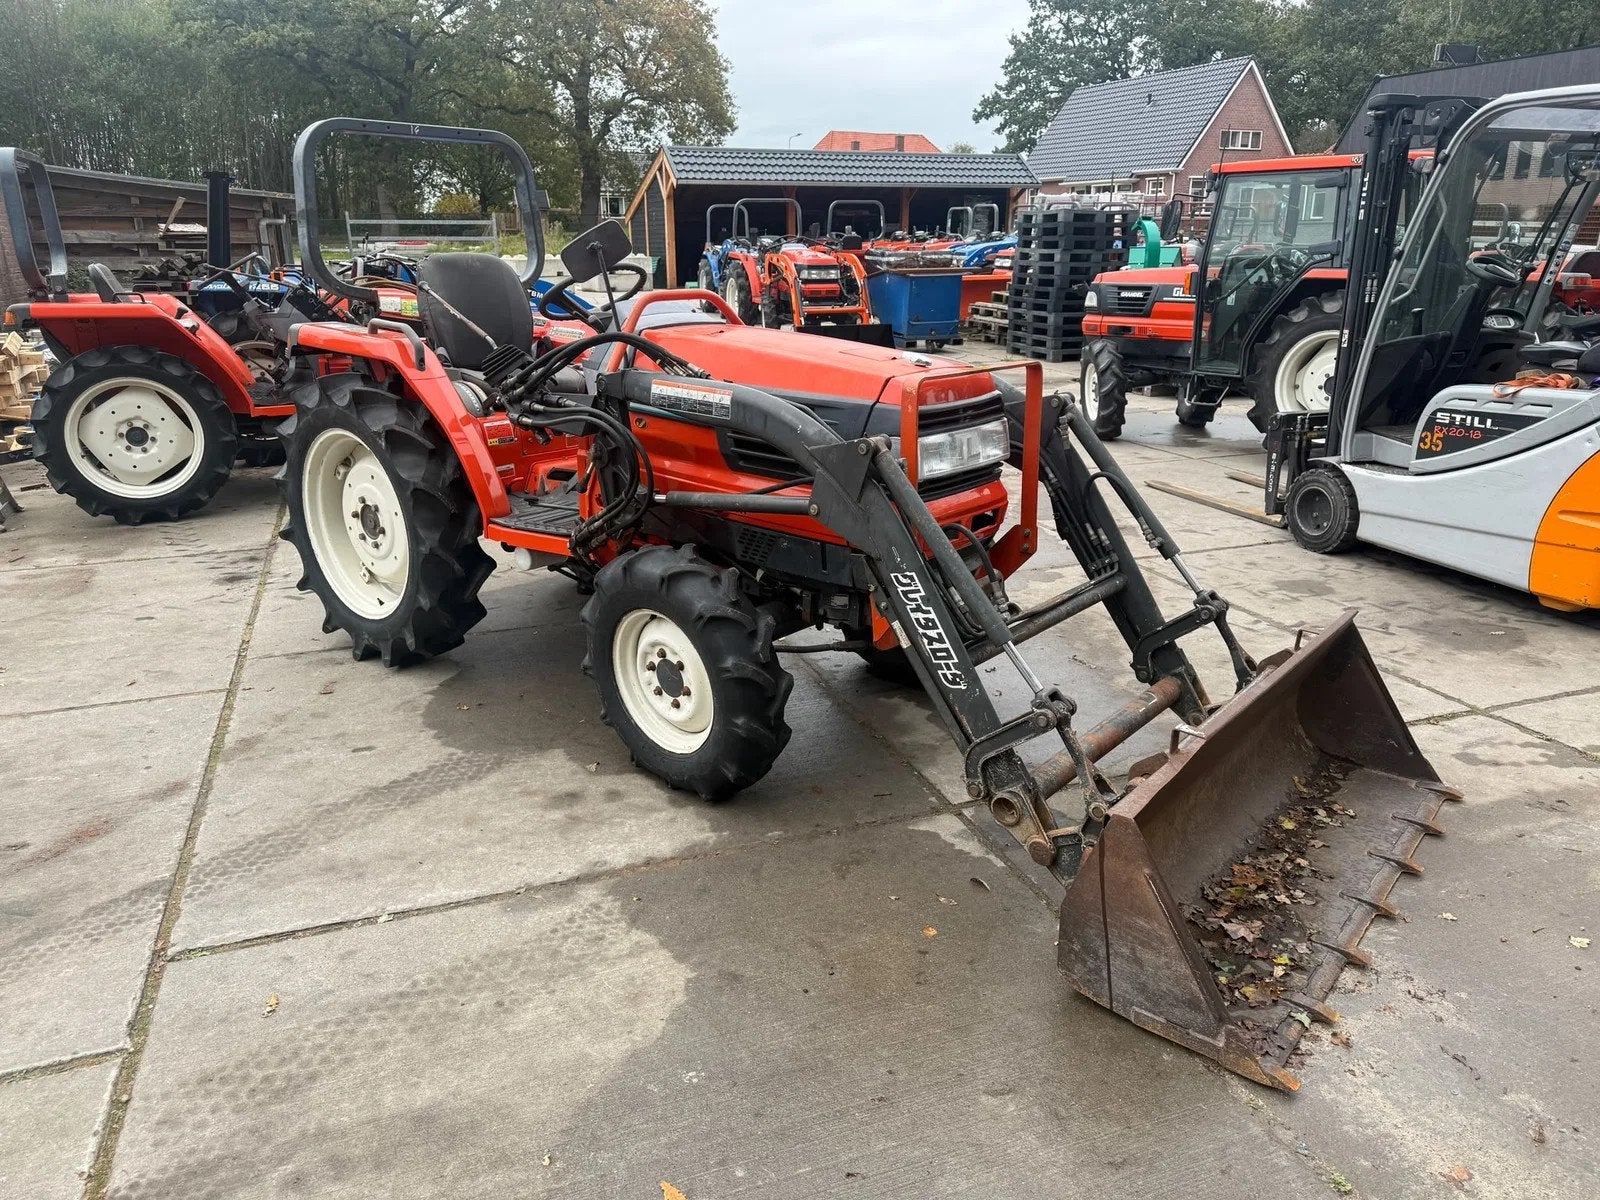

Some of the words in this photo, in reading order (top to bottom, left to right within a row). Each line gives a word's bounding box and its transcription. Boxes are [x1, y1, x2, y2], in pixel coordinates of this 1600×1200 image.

[1359, 172, 1370, 220] STILL
[1435, 412, 1499, 430] STILL
[1420, 431, 1444, 452] 35
[1433, 425, 1482, 439] RX20-18
